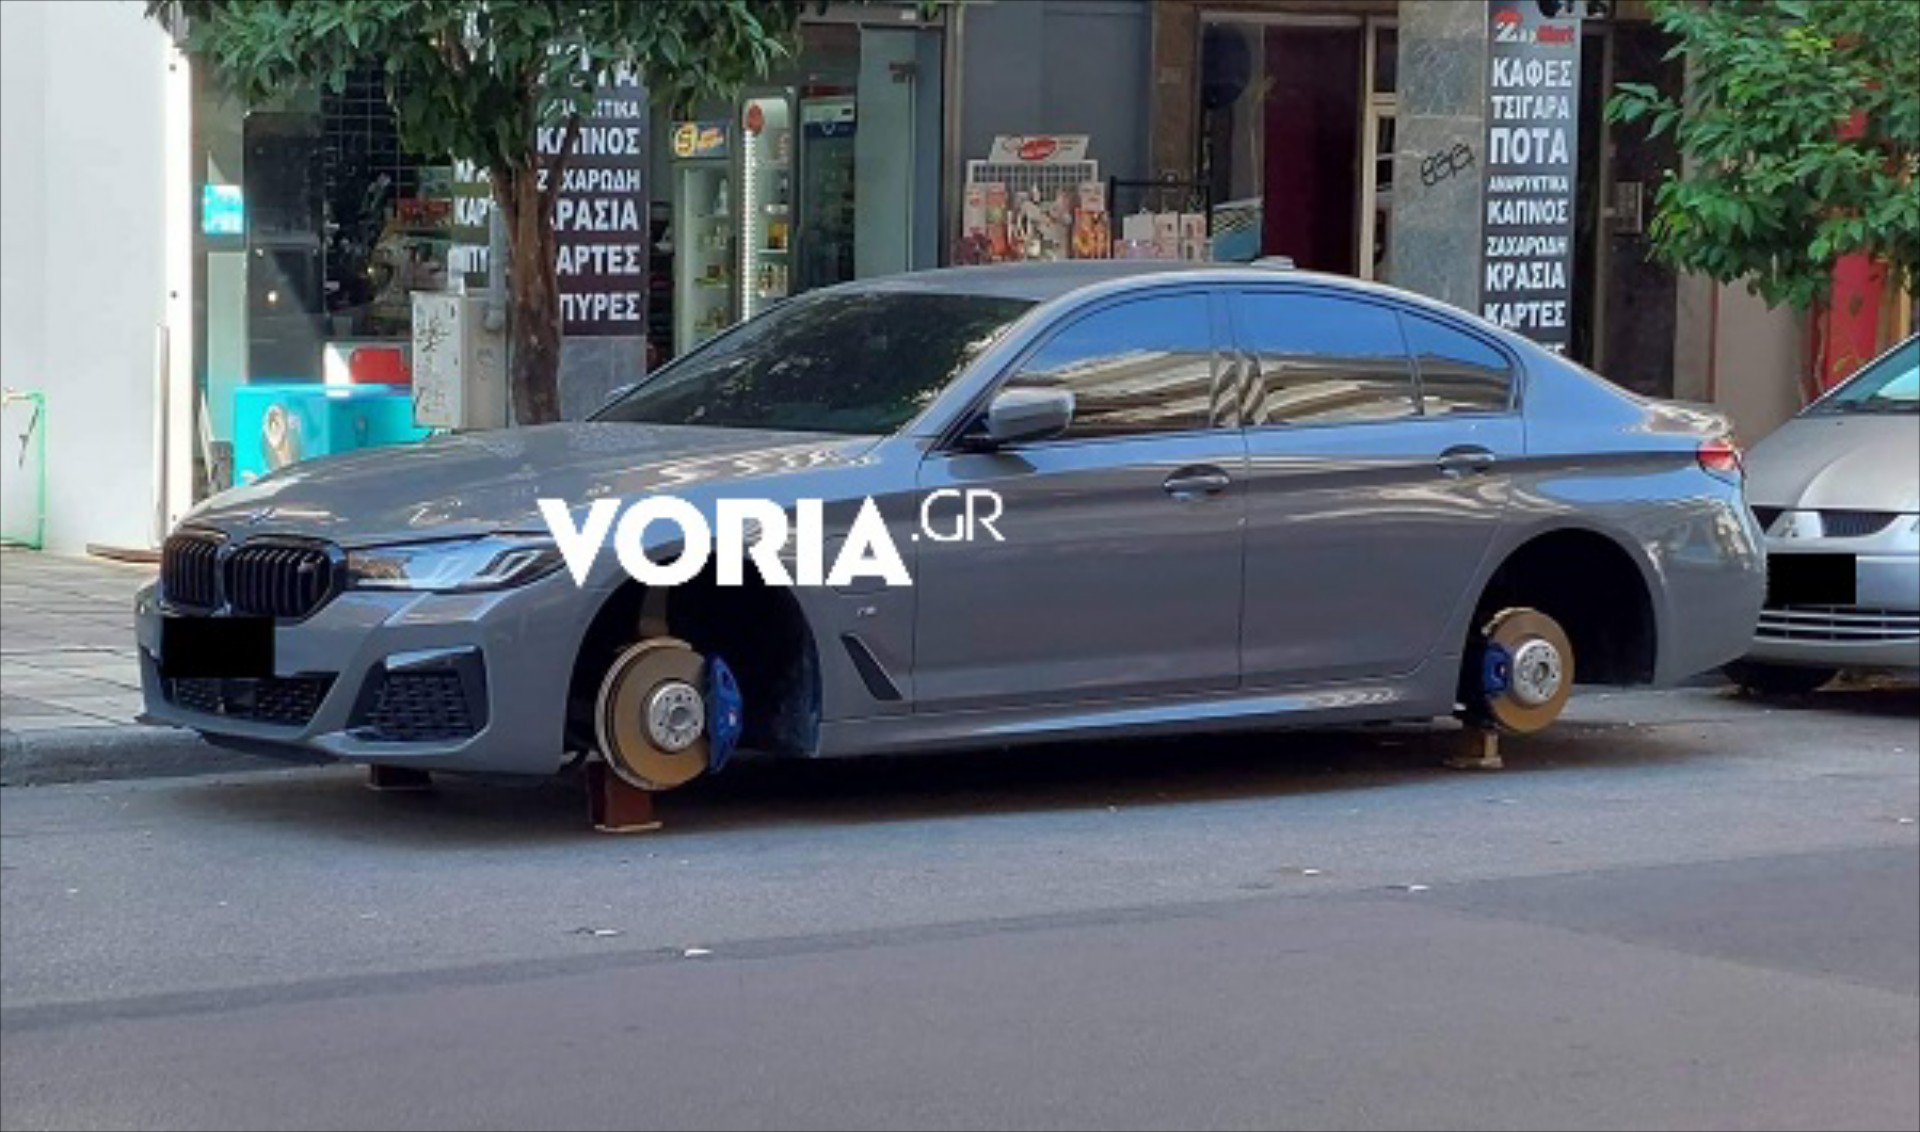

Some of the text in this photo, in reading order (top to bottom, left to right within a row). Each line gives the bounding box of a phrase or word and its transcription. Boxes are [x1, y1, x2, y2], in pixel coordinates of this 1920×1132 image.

[1491, 57, 1572, 87] ΚΑΦΕΣ
[1490, 95, 1569, 119] ΤΣΙΓΑΡΑ
[1490, 127, 1569, 164] ΠΟΤΑ
[537, 169, 640, 191] ΖΧΑΡΩΔΗ
[550, 198, 639, 231] ΡΑΣΙΑ
[1487, 198, 1569, 225] ΚΑΠΝΟΣ
[1486, 235, 1568, 256] ΖΑΧΑΡΩΔΗ
[1486, 262, 1566, 291] ΚΡΑΣΙΑ
[1484, 300, 1566, 327] ΚΑΡΤΕΣ
